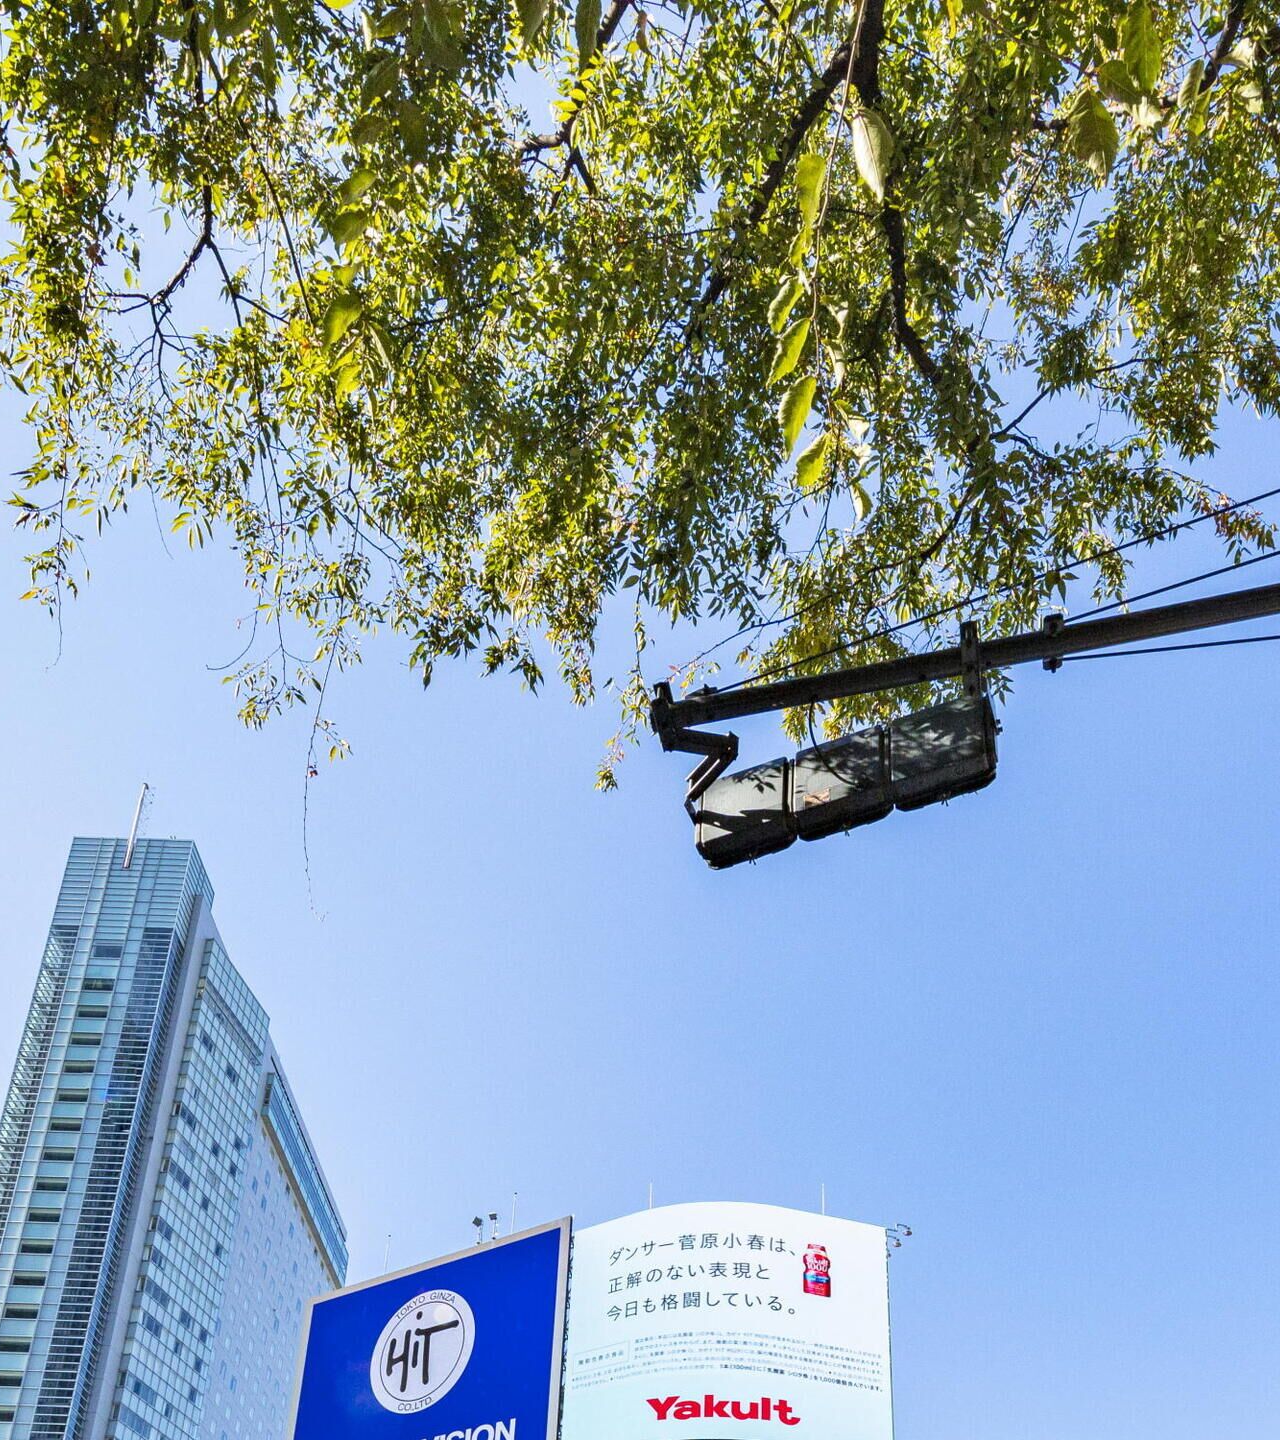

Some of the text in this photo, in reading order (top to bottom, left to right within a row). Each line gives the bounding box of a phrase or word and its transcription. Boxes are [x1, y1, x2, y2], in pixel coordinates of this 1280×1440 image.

[609, 1233, 796, 1266] ダンサー菅原小春は、
[607, 1261, 771, 1294] 正解のない表現と
[395, 1291, 456, 1321] TOKYO GINZA
[606, 1291, 797, 1322] 今日も格闘している。
[646, 1394, 801, 1426] Yakult
